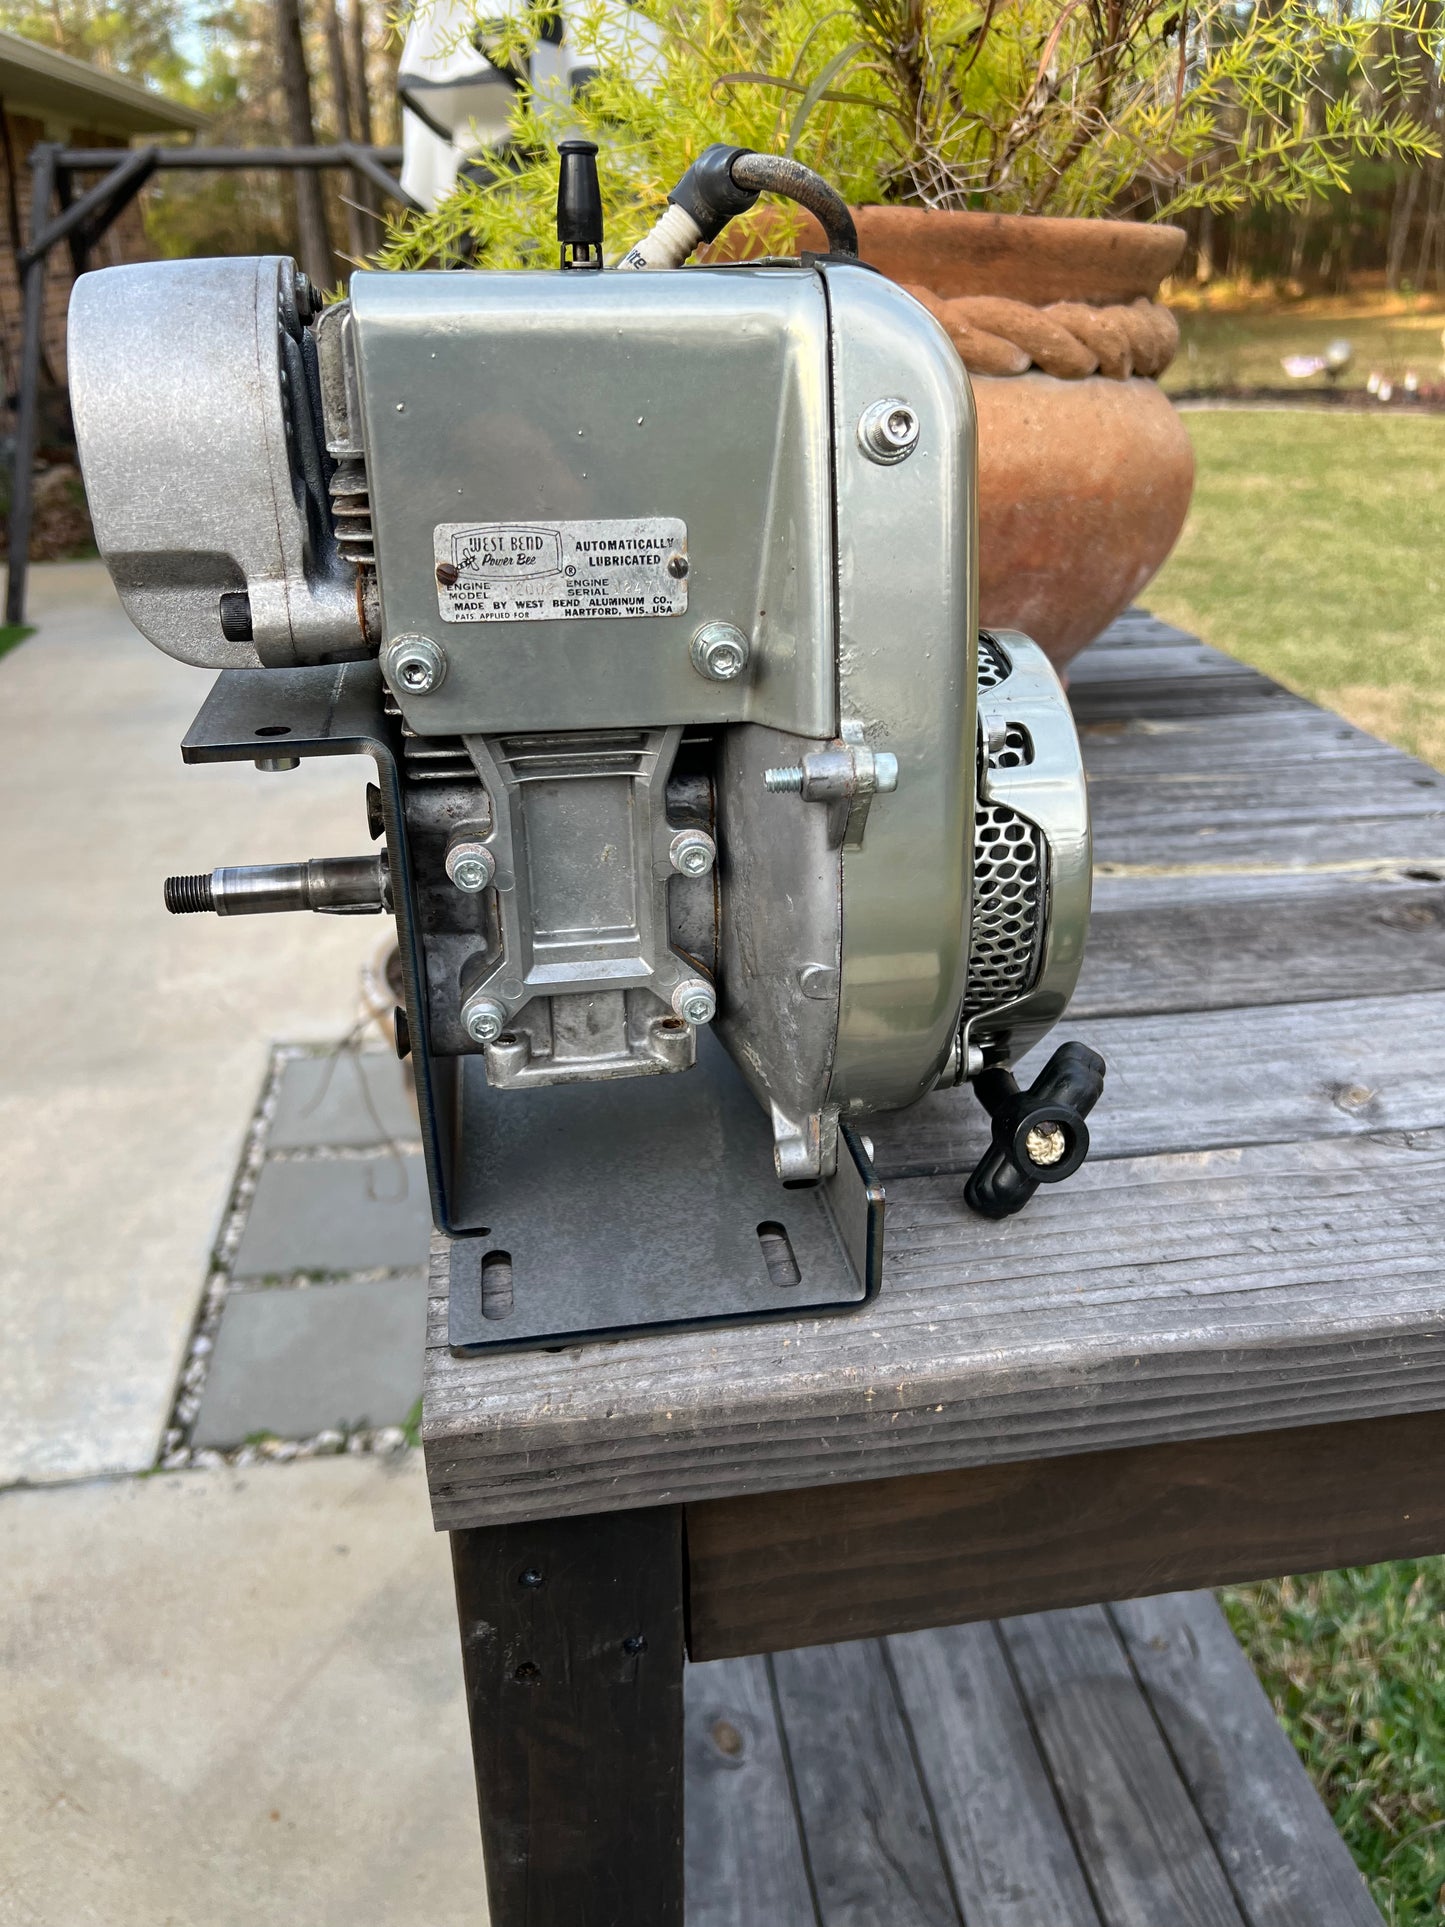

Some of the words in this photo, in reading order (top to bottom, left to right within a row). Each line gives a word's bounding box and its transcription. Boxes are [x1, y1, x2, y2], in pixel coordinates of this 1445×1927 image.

[469, 537, 504, 552] WEST
[575, 538, 674, 551] AUTOMATICALLY
[482, 553, 514, 566] Power
[516, 553, 537, 565] Bee
[589, 555, 661, 567] LUBRICATED
[446, 582, 491, 592] ENGINE
[566, 579, 609, 587] ENGINE
[449, 592, 491, 601] MODEL
[567, 588, 609, 596] SERIAL
[454, 602, 485, 611] MADE
[493, 601, 507, 610] BY
[515, 600, 544, 609] WEST
[552, 599, 580, 607] BEND
[589, 597, 645, 606] ALUMINUM
[653, 605, 673, 613] USA
